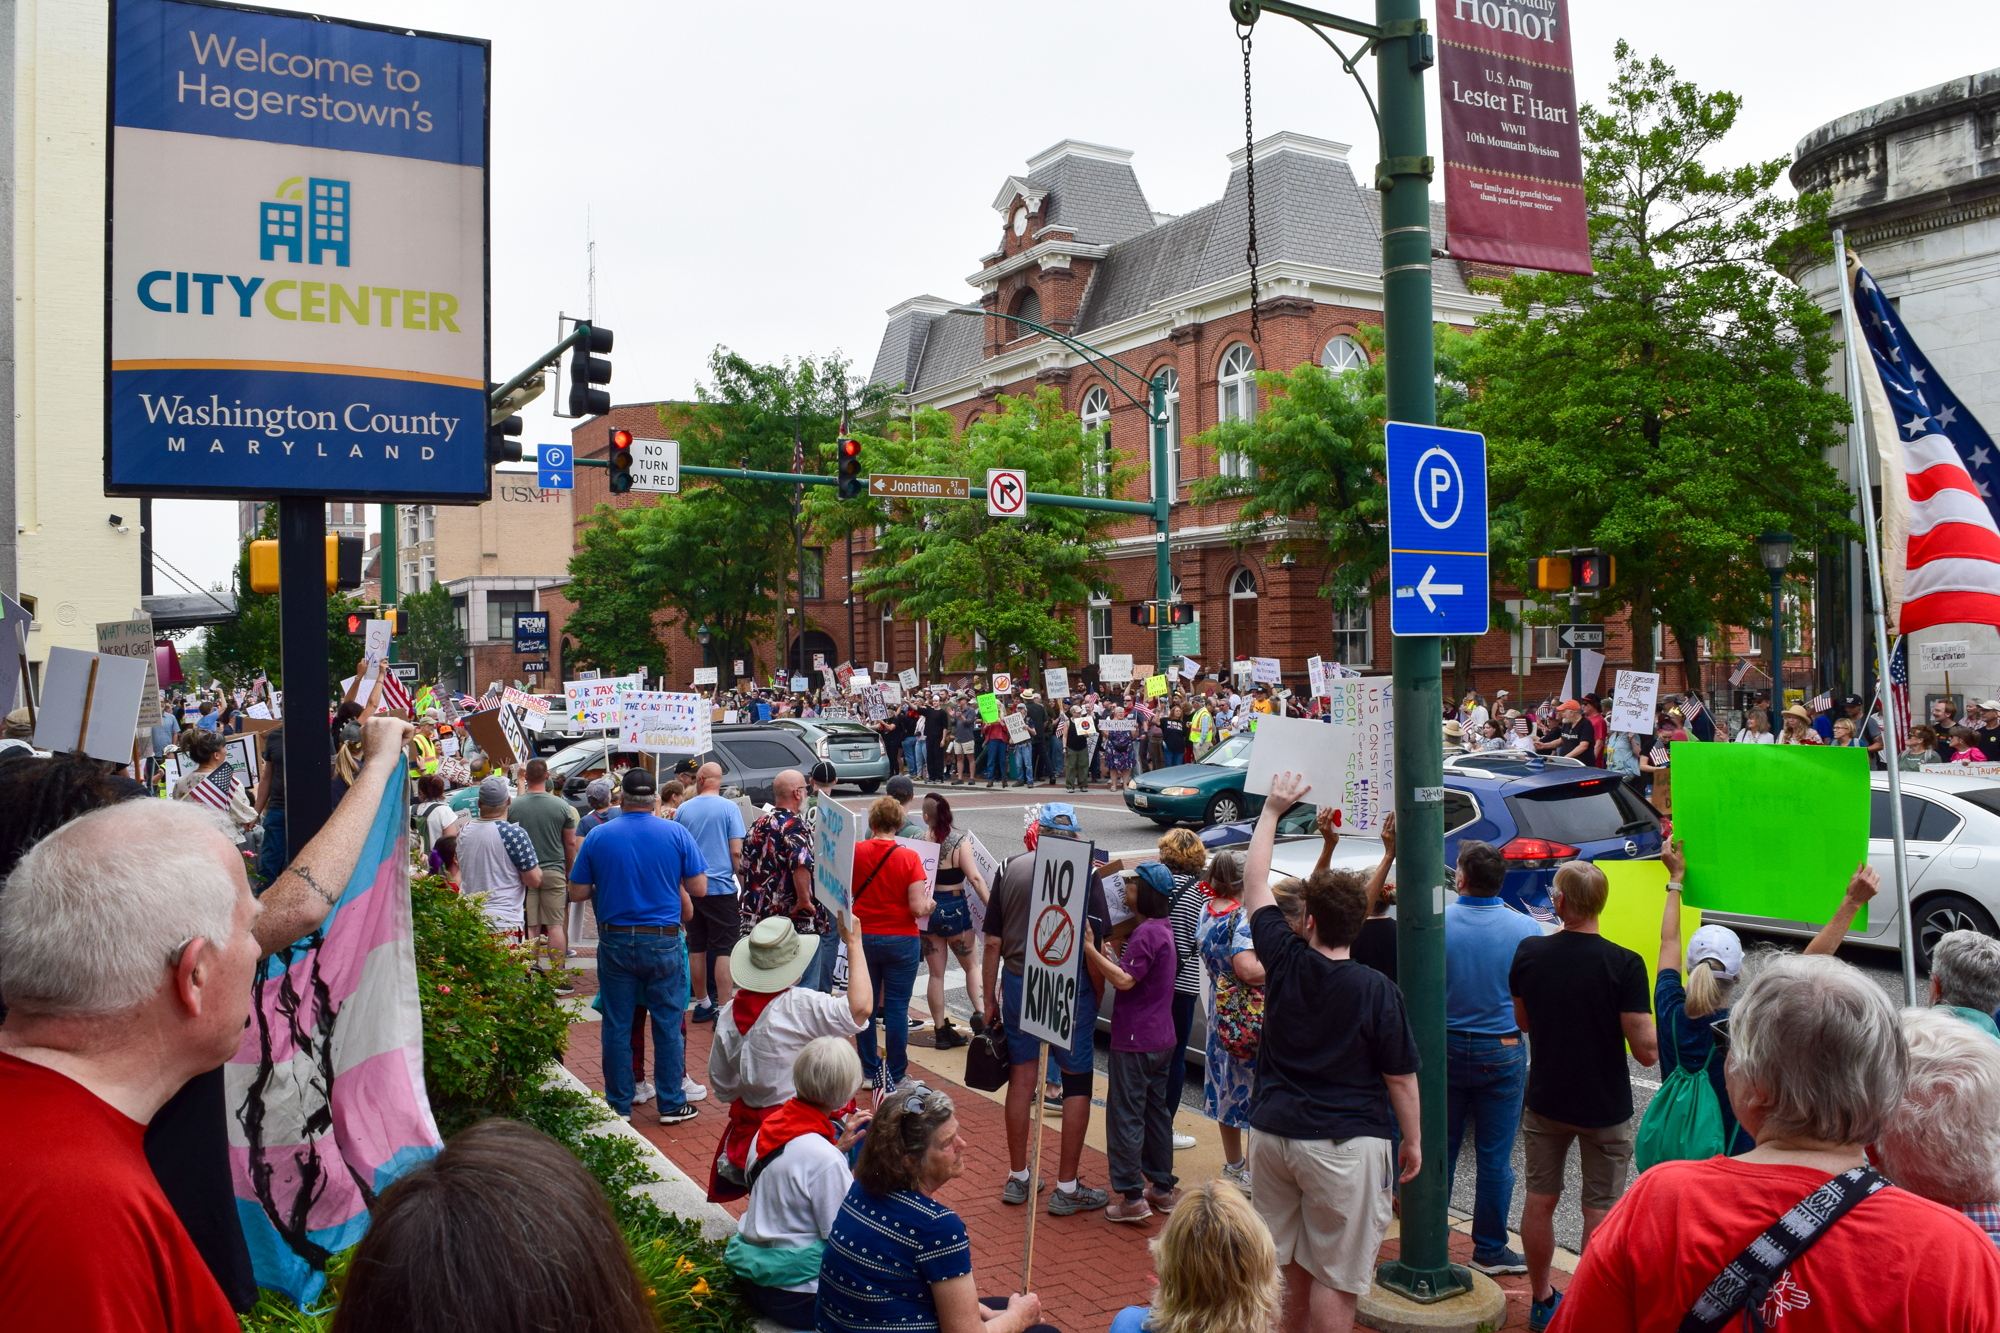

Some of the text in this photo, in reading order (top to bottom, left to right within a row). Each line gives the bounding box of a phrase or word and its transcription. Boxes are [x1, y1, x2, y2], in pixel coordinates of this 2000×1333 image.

[1453, 0, 1556, 44] Honor
[189, 30, 421, 93] Welcome to
[1485, 69, 1533, 94] U.S. Army
[178, 71, 434, 133] Hagerstown's
[1452, 80, 1570, 125] Lester F. Hart
[1500, 121, 1527, 136] WWII
[1466, 131, 1560, 158] 10th Mountain Division
[1469, 180, 1483, 190] Your
[1484, 182, 1502, 194] family
[1503, 187, 1515, 195] and
[1520, 190, 1542, 200] grateful
[1542, 193, 1562, 203] Nation
[1480, 192, 1554, 212] thank you for your service
[138, 393, 461, 442] Washington County
[644, 446, 662, 456] NO
[639, 460, 668, 471] TURN
[632, 474, 675, 486] ON RED
[890, 480, 942, 494] Jonathan
[1430, 467, 1451, 509] P
[501, 486, 566, 503] USMH
[97, 623, 151, 641] WHAT MAKES
[518, 617, 546, 628] F&M
[1574, 632, 1600, 641] ONE WAY
[524, 663, 544, 671] ATM
[505, 686, 550, 708] TINY HANDS
[568, 687, 590, 699] OUR
[594, 684, 614, 696] TAX
[503, 694, 548, 716] HUGE BRIBES
[574, 696, 620, 710] PAYING FOR
[624, 702, 640, 711] THE
[630, 732, 696, 748] A KINGDOM
[1368, 688, 1379, 826] US CONSTITUTION
[1359, 781, 1369, 830] HUMAN
[818, 806, 844, 836] STOP
[818, 864, 848, 910] MADNESS
[1041, 858, 1074, 908] NO
[1024, 964, 1075, 1041] KINGS
